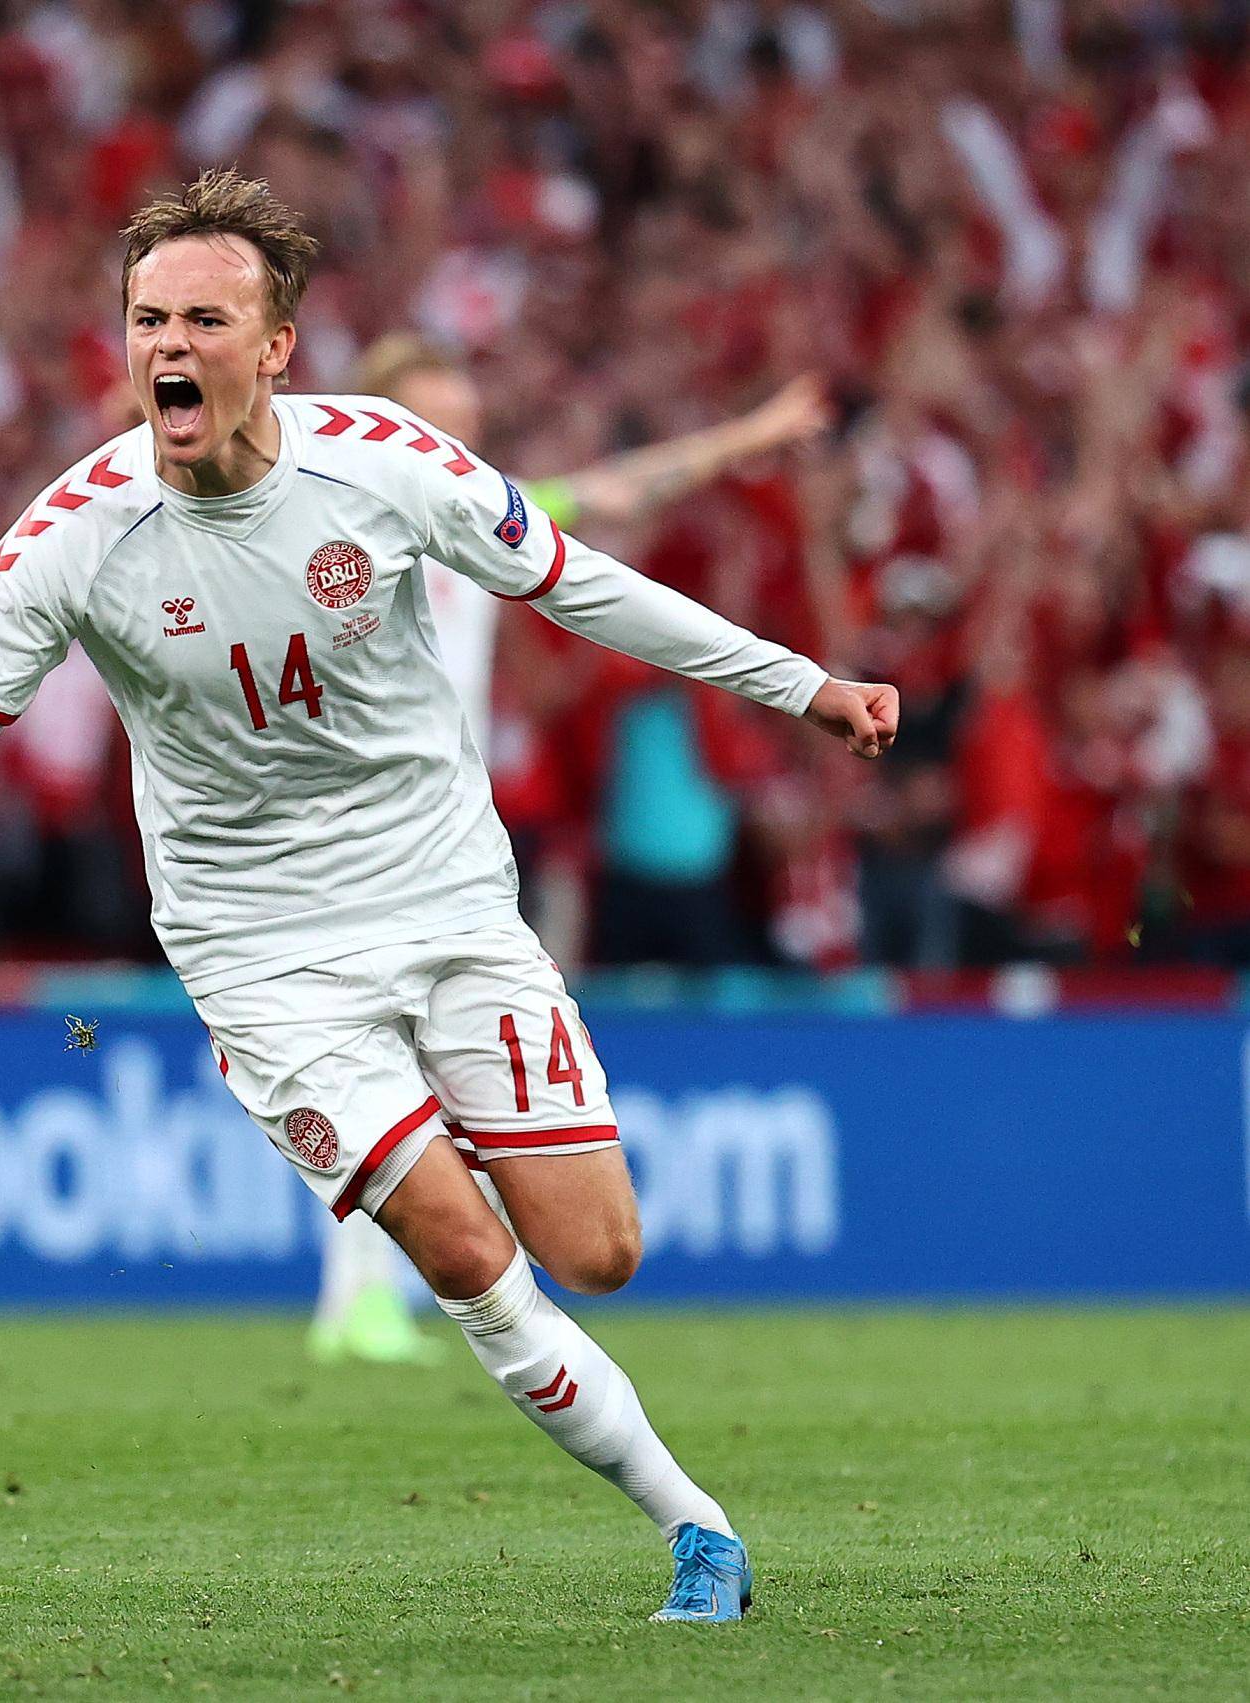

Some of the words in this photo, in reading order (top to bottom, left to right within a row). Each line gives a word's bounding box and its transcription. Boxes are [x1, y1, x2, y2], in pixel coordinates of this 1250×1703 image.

[307, 571, 330, 606] DANSK
[357, 555, 371, 592] UNION
[318, 561, 359, 589] DBU
[333, 593, 360, 609] 1889
[162, 621, 206, 637] hummel
[230, 632, 323, 731] 14
[499, 1007, 586, 1113] 14
[300, 1121, 327, 1154] DBU
